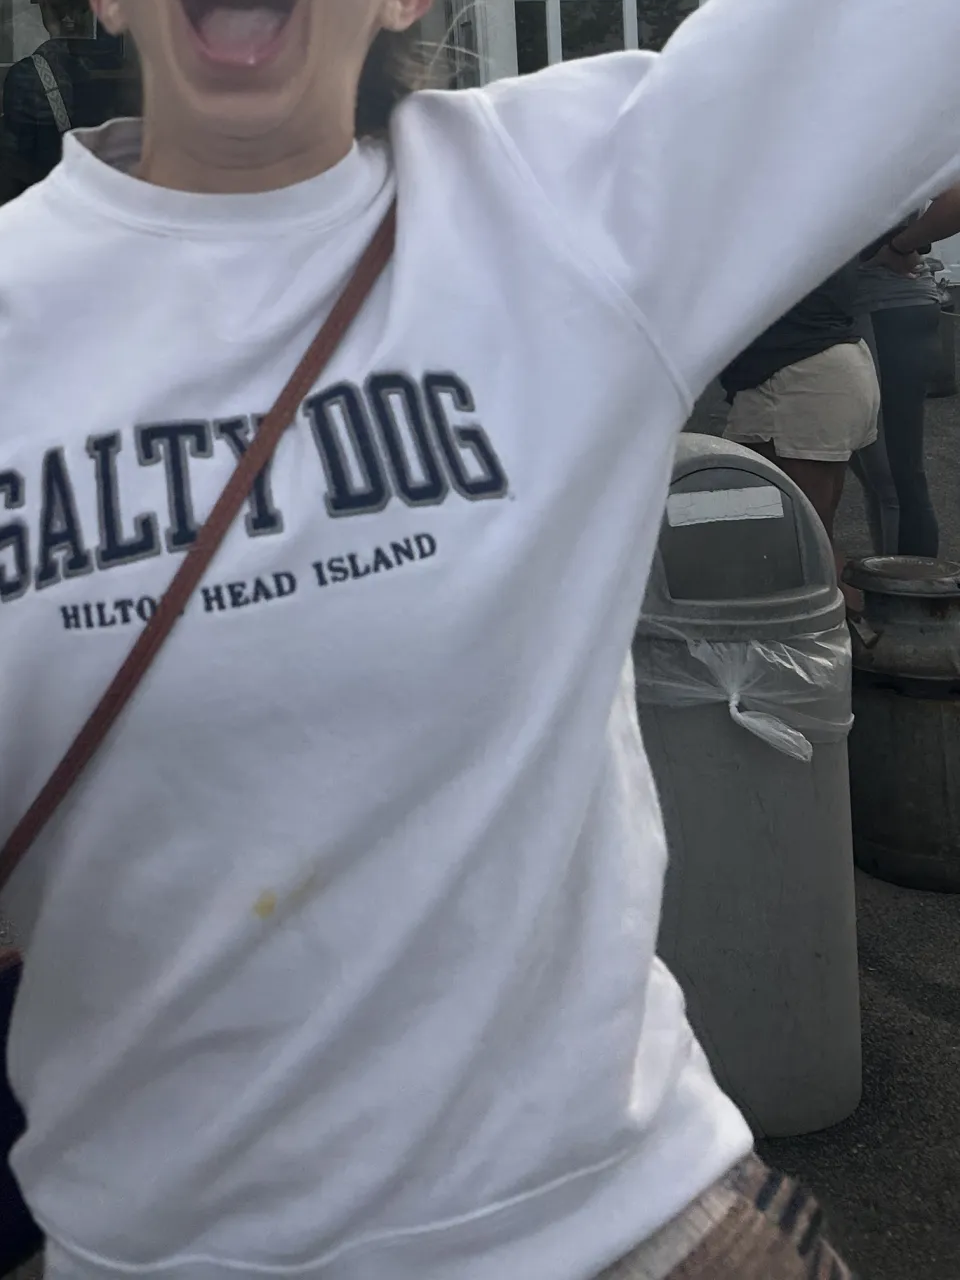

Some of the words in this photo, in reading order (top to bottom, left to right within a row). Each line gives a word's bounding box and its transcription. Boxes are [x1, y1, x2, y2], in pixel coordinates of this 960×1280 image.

[303, 370, 509, 517] DOG
[60, 594, 184, 630] HILTO
[201, 570, 297, 613] HEAD
[312, 533, 438, 588] ISLAND
